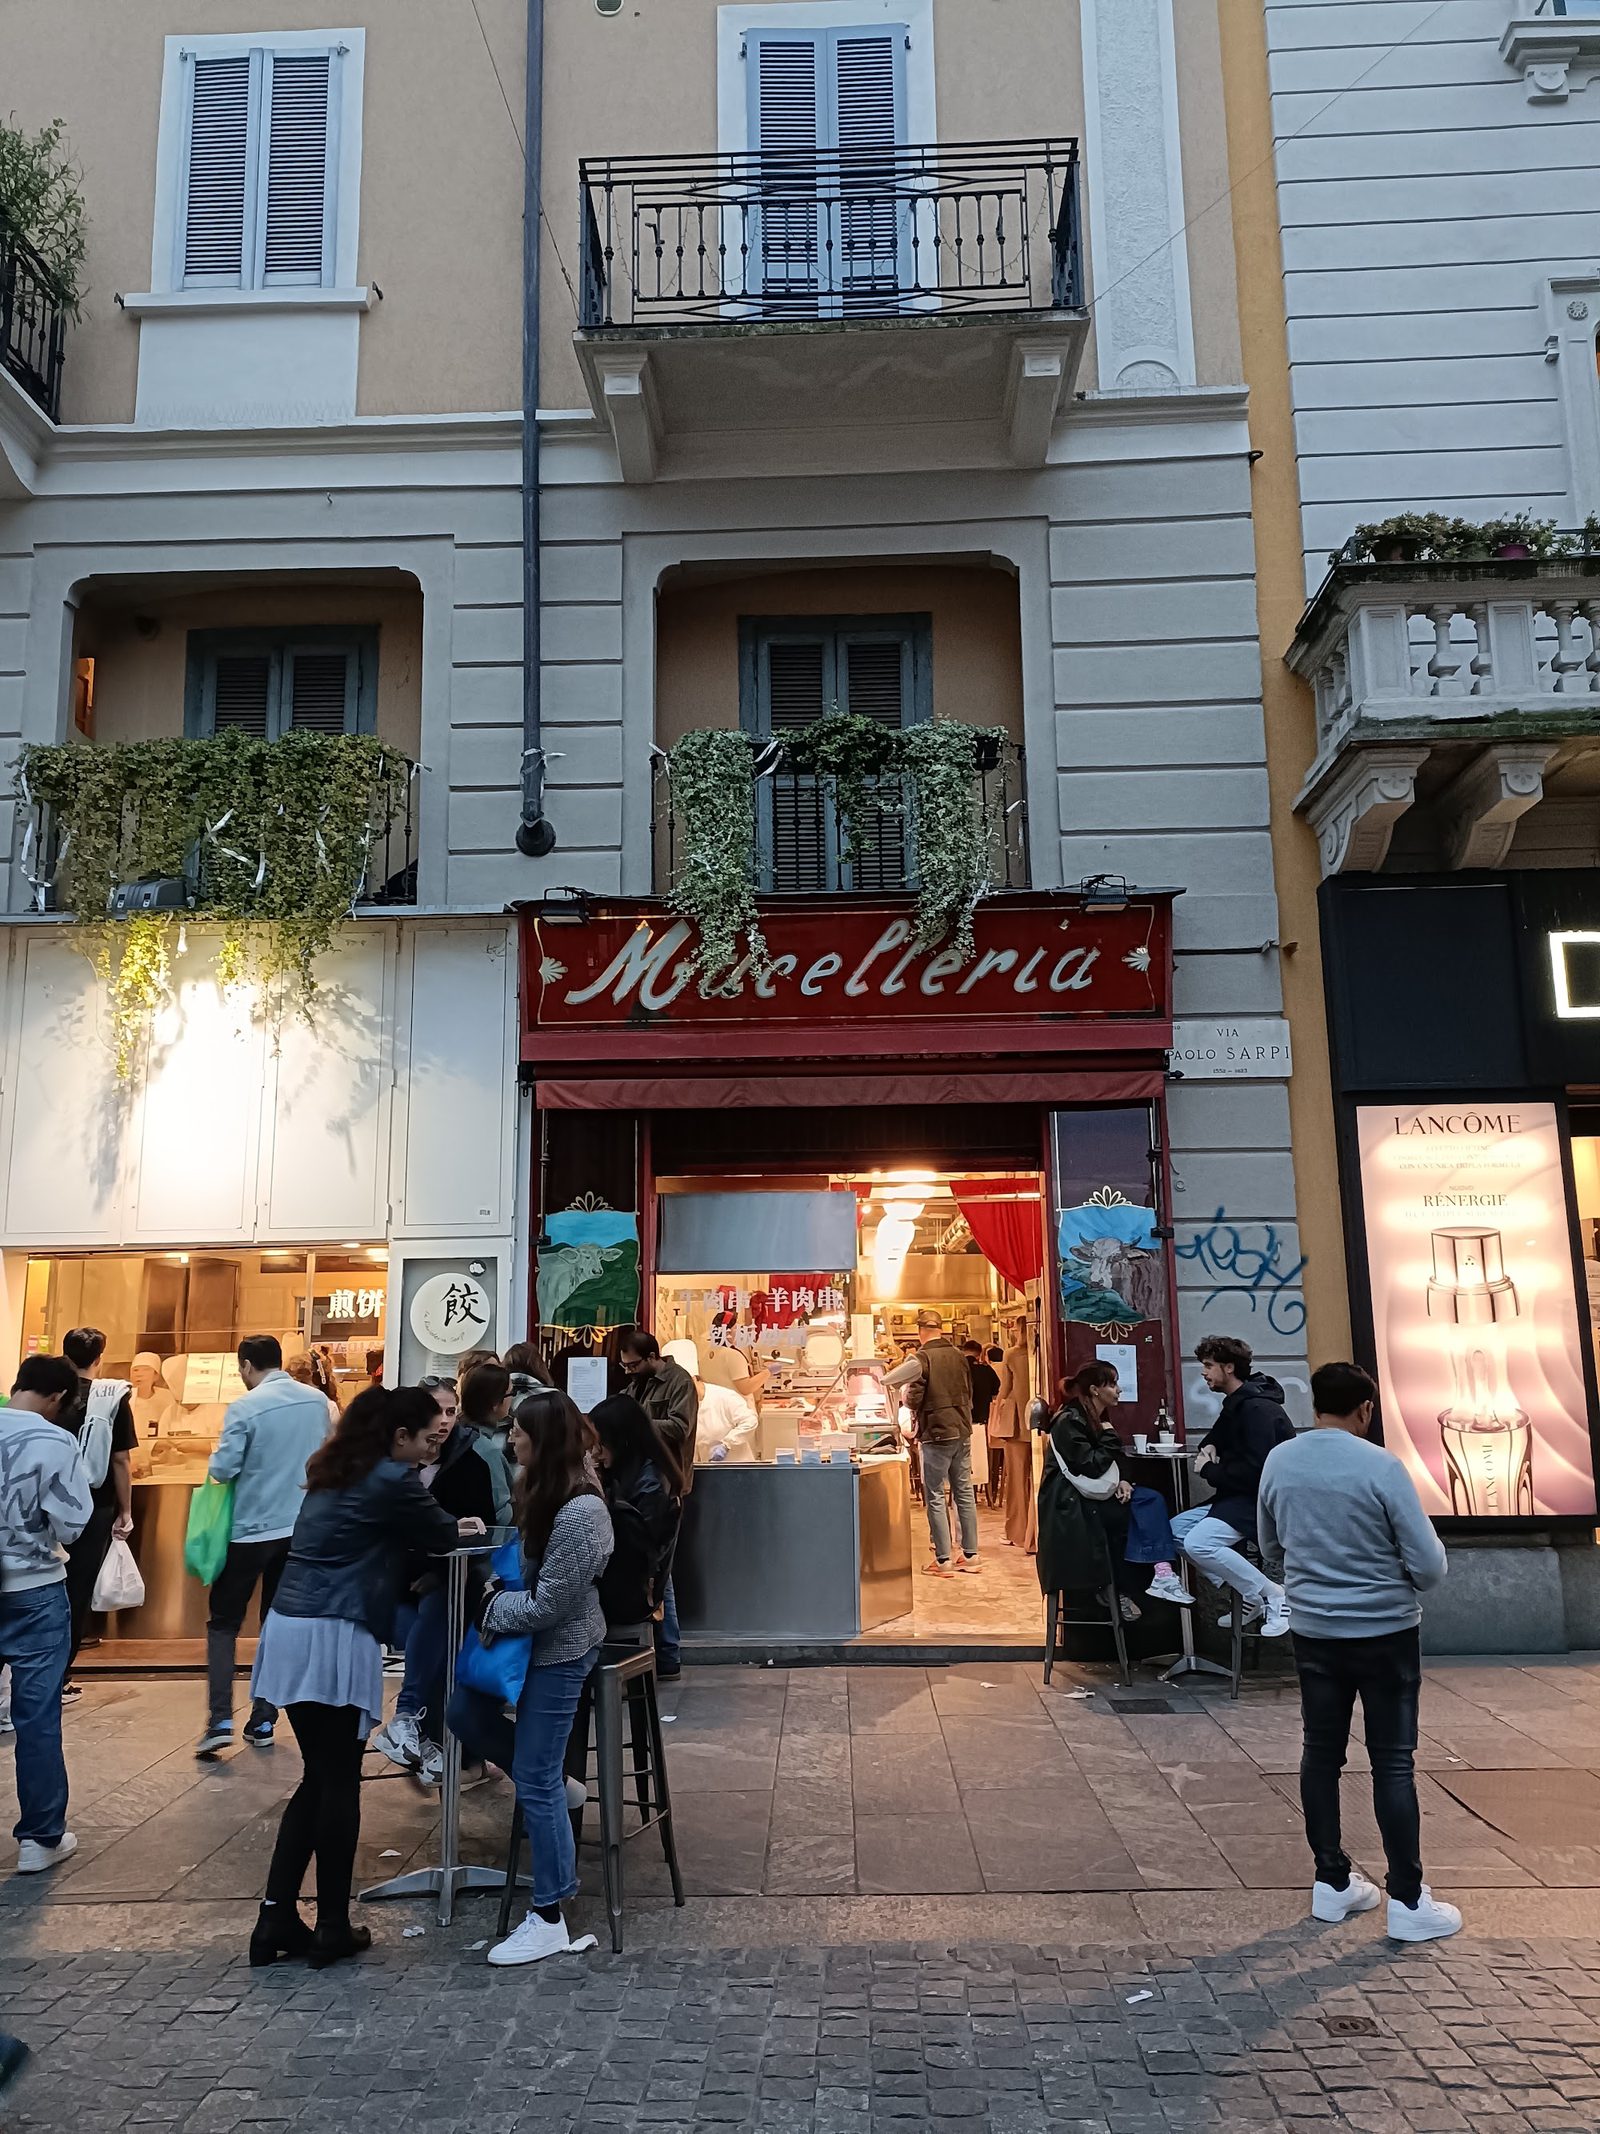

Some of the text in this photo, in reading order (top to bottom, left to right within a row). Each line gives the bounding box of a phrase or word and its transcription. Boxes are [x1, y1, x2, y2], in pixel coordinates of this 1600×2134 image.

[564, 918, 1101, 1010] Macelleria
[1216, 1028, 1239, 1037] VIA
[1167, 1046, 1290, 1060] PAOLO SARPI
[1394, 1111, 1522, 1135] LANCÔME
[1423, 1191, 1508, 1207] RÉNERGIE
[326, 1288, 386, 1319] 煎饼
[440, 1283, 487, 1327] 餃
[765, 1286, 839, 1313] 羊肉串
